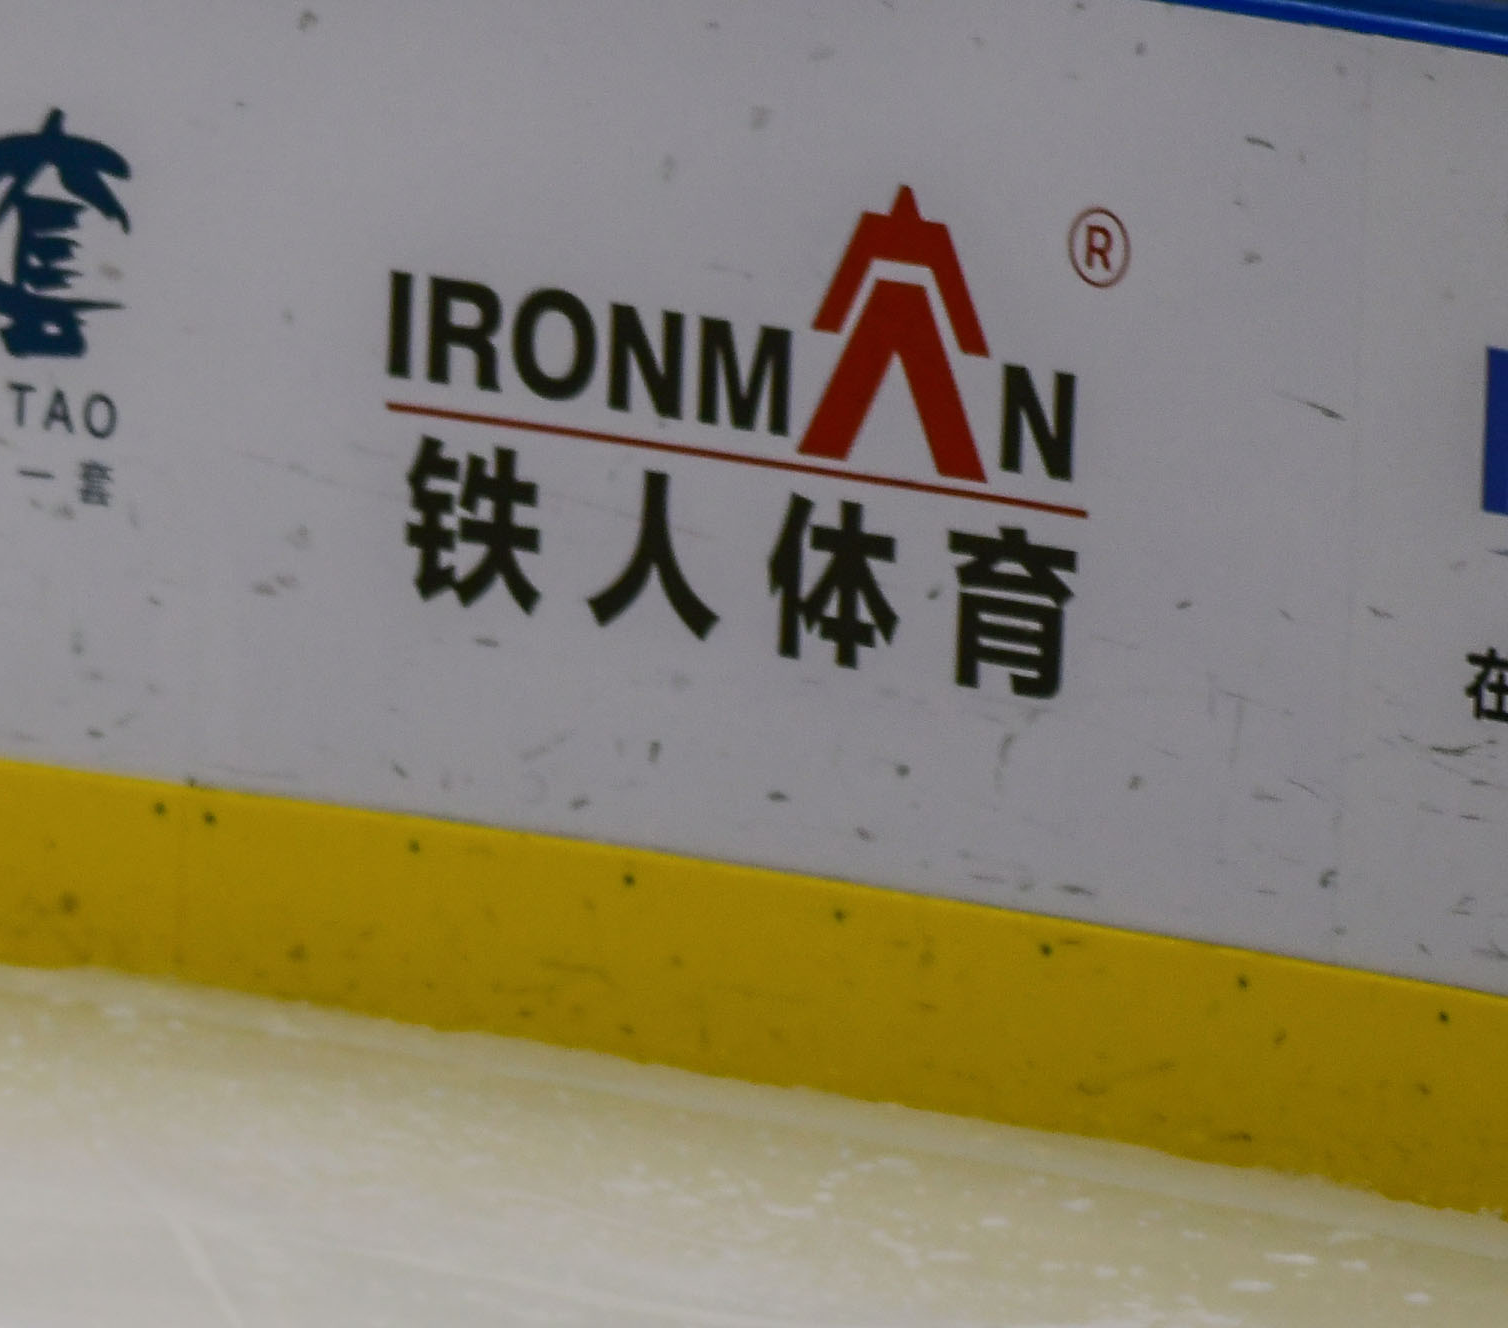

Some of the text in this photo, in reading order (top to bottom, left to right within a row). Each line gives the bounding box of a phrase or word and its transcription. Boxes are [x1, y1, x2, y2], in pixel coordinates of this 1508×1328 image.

[8, 380, 118, 440] TAO
[385, 184, 1078, 484] IRONMAN
[403, 434, 1078, 703] 铁人体育
